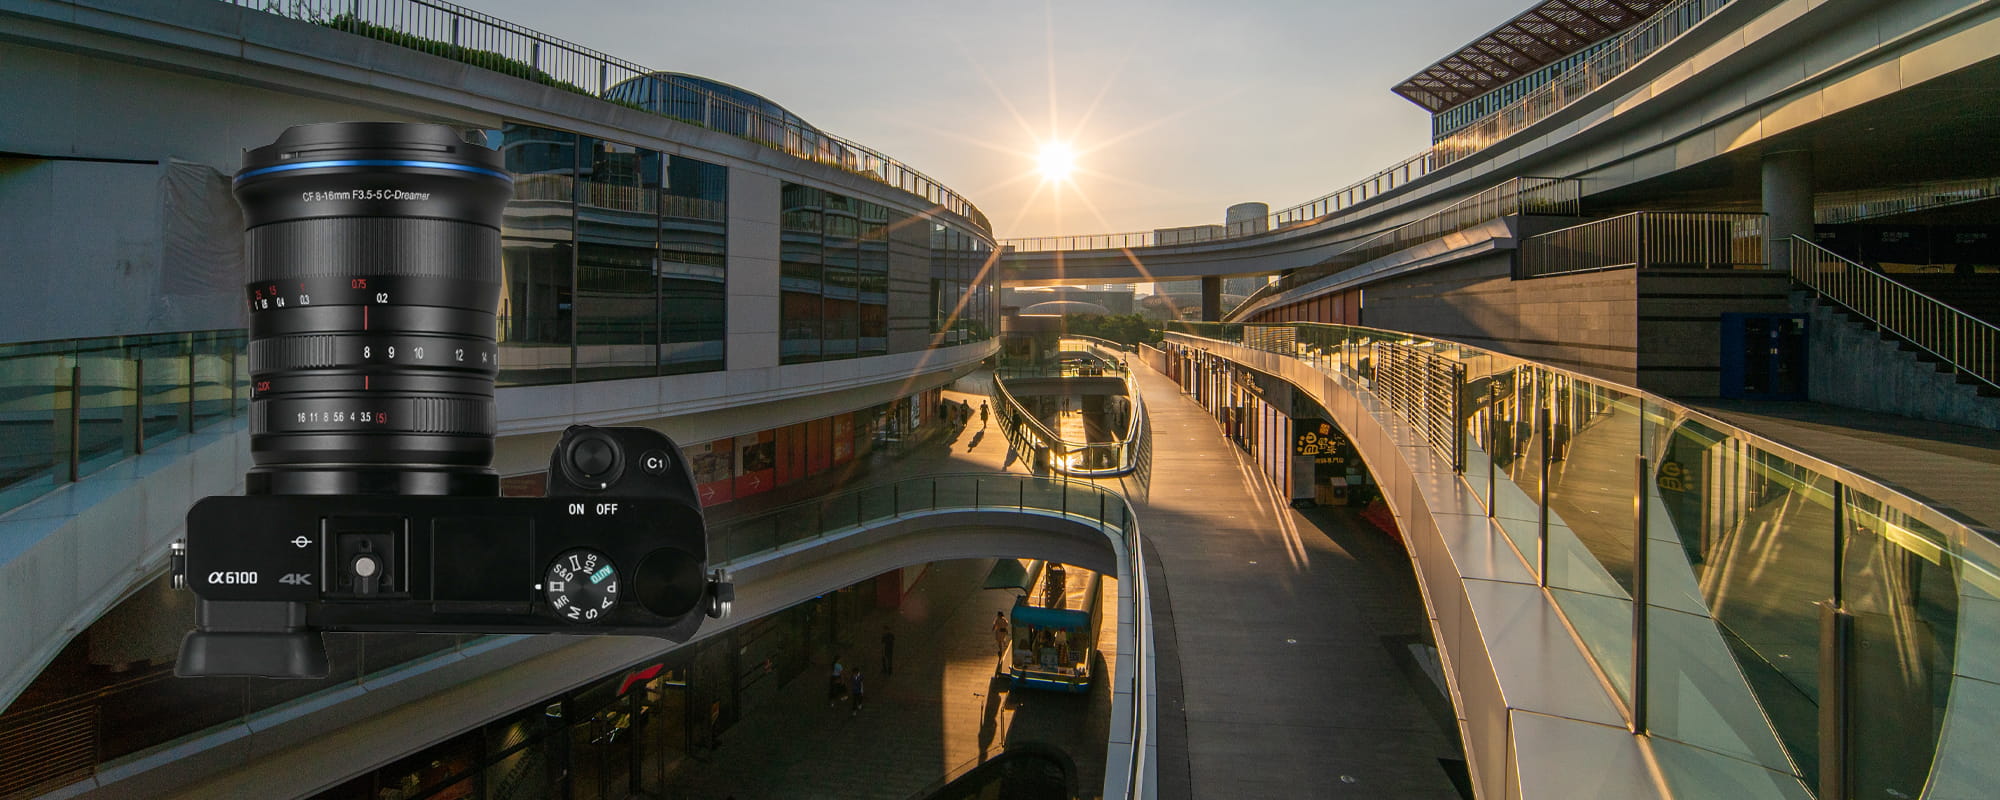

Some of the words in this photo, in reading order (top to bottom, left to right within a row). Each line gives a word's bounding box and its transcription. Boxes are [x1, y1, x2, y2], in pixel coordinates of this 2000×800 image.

[302, 192, 314, 202] CF
[315, 191, 351, 202] 8-16mm
[352, 190, 382, 200] F3.5-5
[383, 189, 430, 201] C-Dreamer
[351, 279, 367, 289] 0.75
[299, 294, 310, 305] 0.3
[376, 293, 388, 304] 0.2
[363, 346, 371, 358] 8
[388, 346, 395, 359] 9
[413, 347, 424, 360] 10
[455, 348, 464, 362] 12
[297, 412, 306, 423] 16
[310, 412, 318, 422] 11
[323, 412, 329, 422] 8
[333, 412, 344, 422] 5.6
[350, 412, 356, 422] 4
[360, 412, 371, 422] 3.5
[375, 412, 388, 424] (5)
[646, 456, 664, 470] C1
[568, 503, 585, 516] ON
[596, 503, 618, 516] OFF
[583, 553, 598, 575] SCN
[279, 573, 312, 585] 4K
[591, 565, 612, 584] AUTO
[606, 581, 616, 593] P
[553, 595, 571, 610] MR
[602, 596, 614, 609] A
[567, 605, 582, 620] M
[585, 608, 599, 620] S
